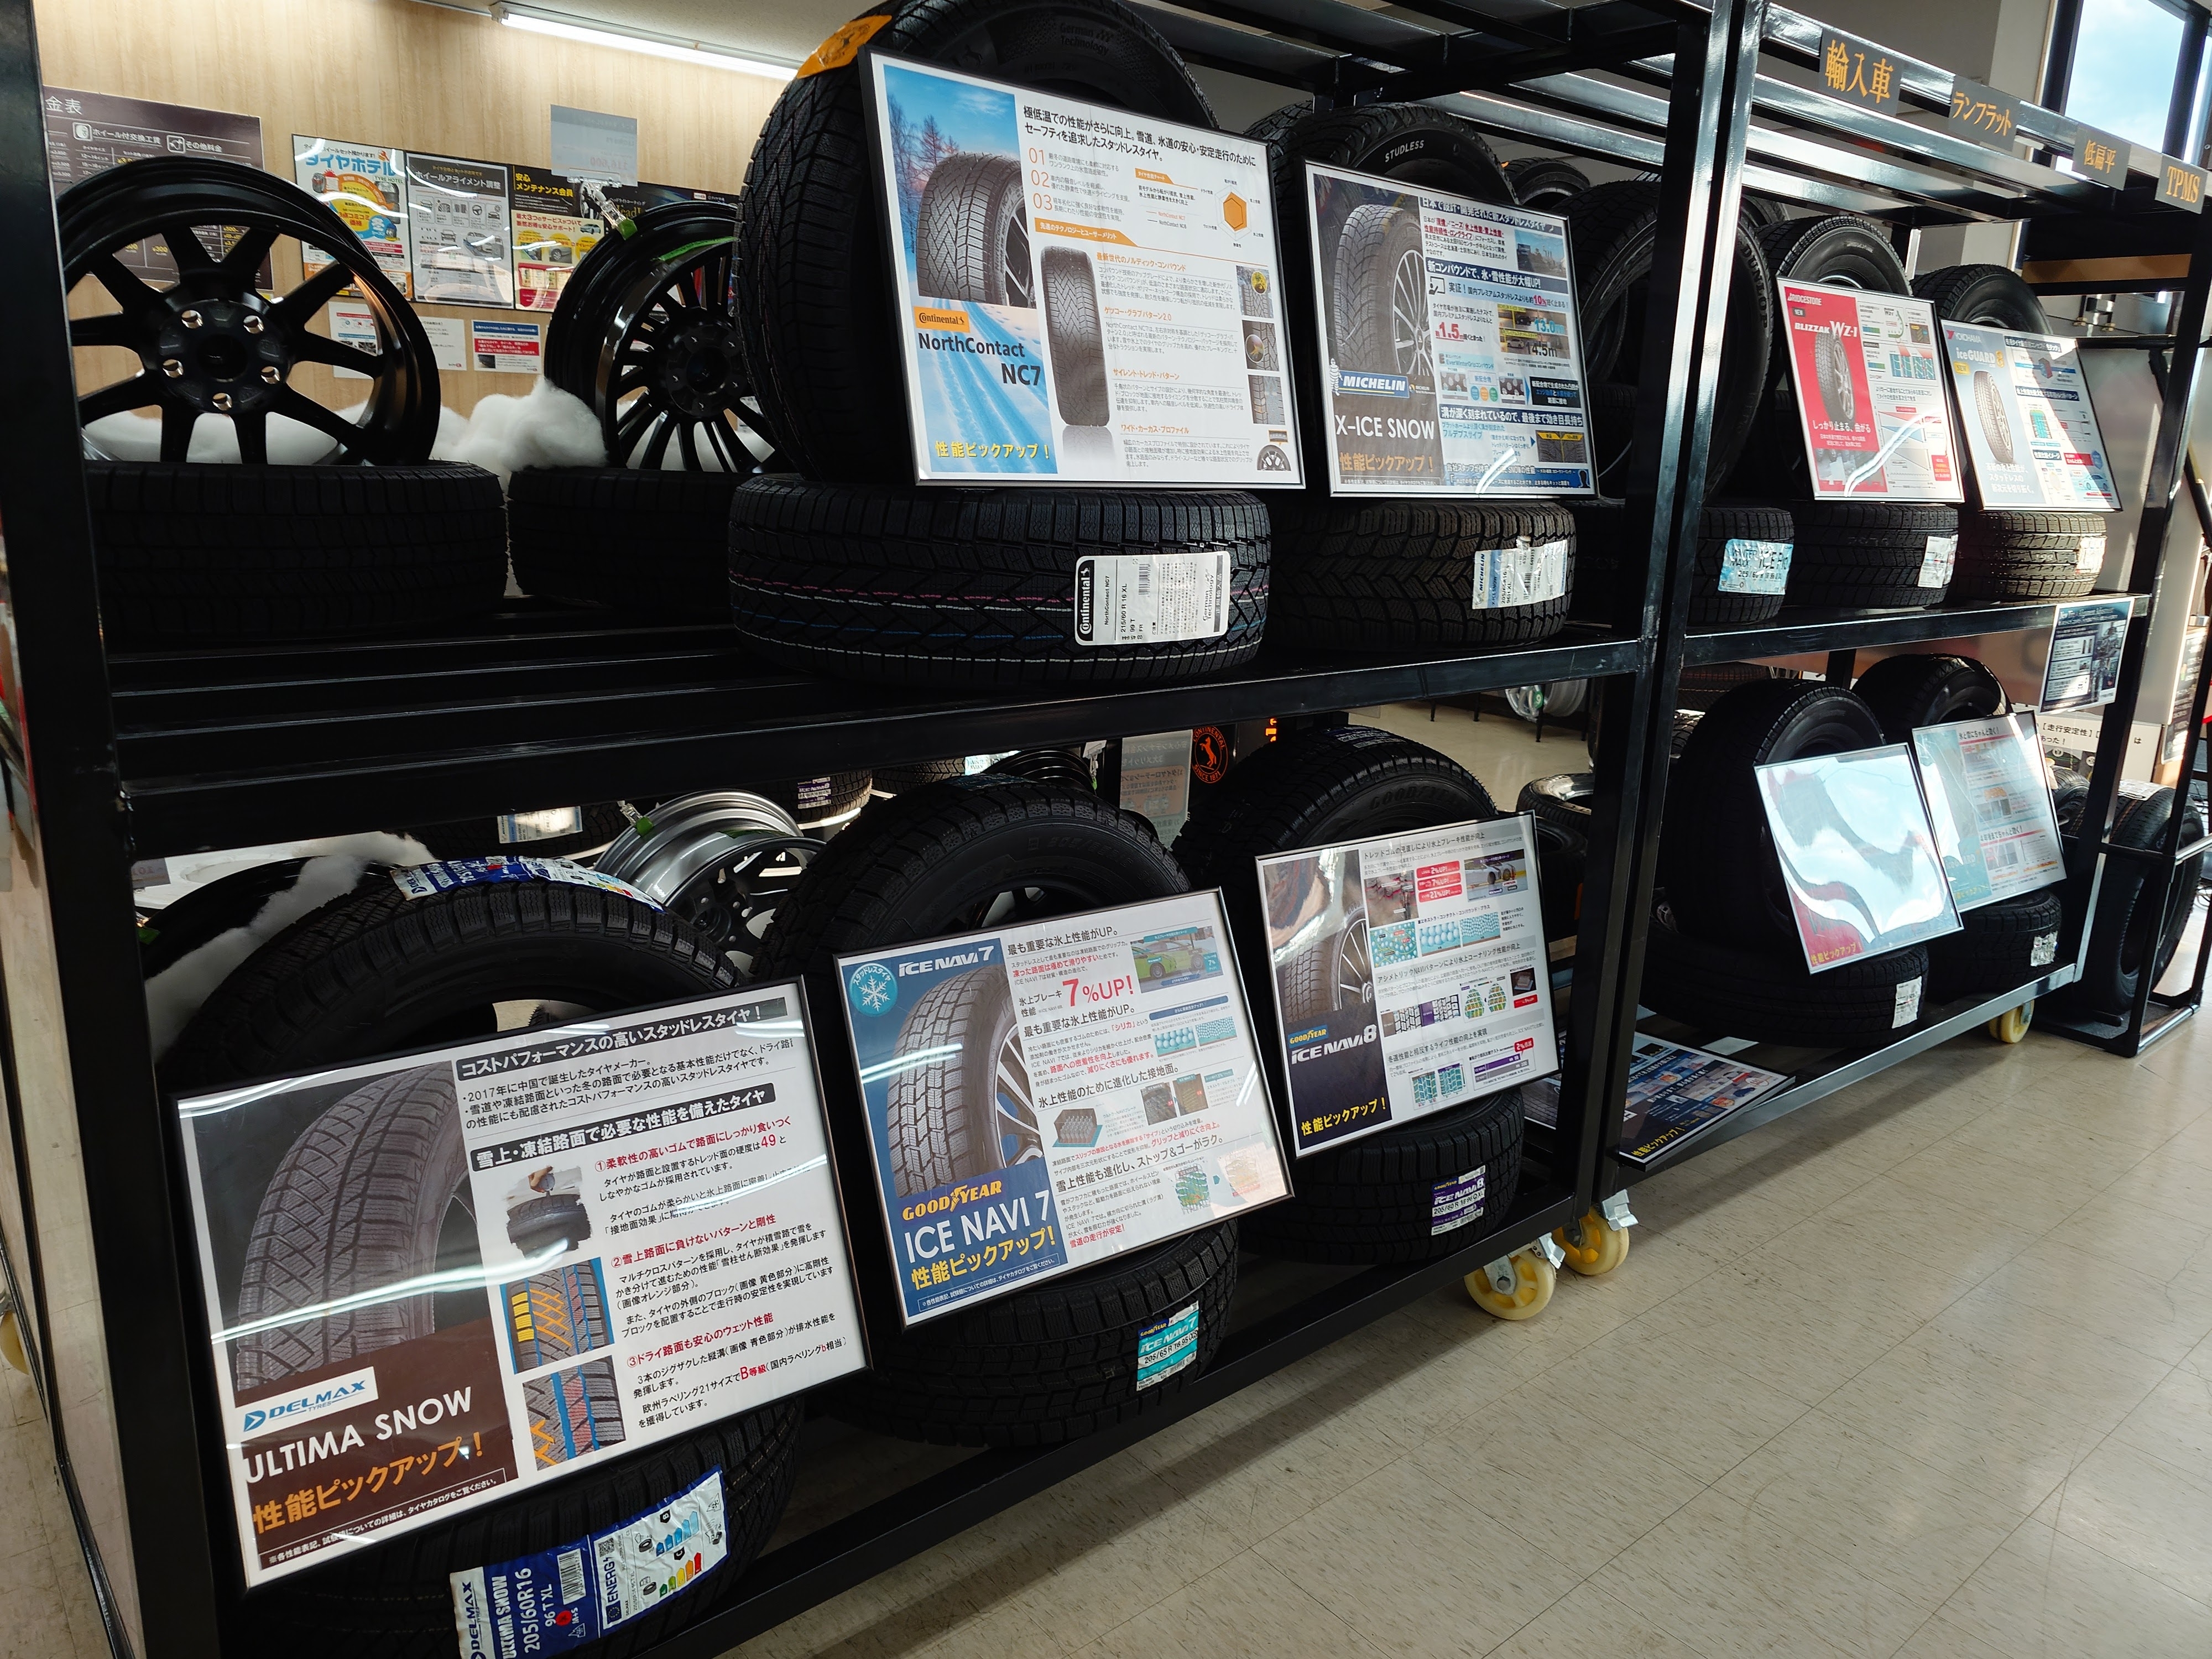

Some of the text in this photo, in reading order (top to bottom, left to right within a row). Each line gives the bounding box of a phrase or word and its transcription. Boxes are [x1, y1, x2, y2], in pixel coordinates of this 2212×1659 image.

[1825, 39, 1893, 105] 輸入車
[45, 95, 82, 115] 金表
[1953, 91, 2012, 137] ランフラット
[1029, 148, 1045, 165] 01
[1385, 140, 1424, 163] STUDLESS
[2084, 139, 2116, 174] 低扁平
[1031, 170, 1050, 187] 02
[2167, 165, 2200, 204] TPMS
[1033, 193, 1052, 210] 03
[919, 312, 958, 324] Continental
[1794, 322, 1830, 334] BLIZZAK
[919, 333, 1025, 357] NorthContact
[1955, 347, 1996, 364] iceGUARD
[1001, 363, 1040, 385] NC7
[1343, 375, 1406, 391] MICHELIN
[1335, 415, 1434, 440] X-ICE SNOW
[935, 441, 1049, 459] 性能ピックアップ！
[1340, 452, 1433, 473] 性能ピックアップ！
[1121, 583, 1127, 593] XL
[1079, 577, 1092, 634] Continental
[1192, 726, 1225, 750] CONTINENTAL
[1008, 926, 1118, 955] 最も重要な氷上性能がUP。
[853, 966, 891, 985] スタッドレスタイヤ
[898, 961, 933, 978] ICE
[1019, 989, 1062, 1006] 氷上ブレーキ
[1021, 1007, 1036, 1018] 性能
[1024, 1004, 1135, 1037] 最も重要な氷上性能がUP。
[1290, 1027, 1327, 1045] GOODYEAR
[1291, 1024, 1377, 1066] ICE NAVI 8
[1301, 1097, 1386, 1137] 性能ピックアップ！
[902, 1180, 1002, 1221] GOODYEAR
[1434, 1178, 1484, 1205] ICE NAVI 8
[905, 1190, 1050, 1263] ICE NAVI 7
[1070, 1223, 1125, 1248] 雪道の走行が安定!
[911, 1225, 1056, 1291] 性能ピックアップ!
[1140, 1316, 1197, 1354] ICE NAVI 7
[1145, 1348, 1167, 1364] 205/65
[269, 1380, 366, 1418] DELMAX
[633, 1379, 680, 1399] 発揮します。
[307, 1401, 332, 1412] TYRES
[638, 1401, 709, 1428] を獲得しています。
[244, 1386, 471, 1484] ULTIMA SNOW
[253, 1432, 483, 1535] 性能ピックアップ！
[540, 1584, 553, 1601] XL
[462, 1581, 479, 1650] DELMAX
[492, 1575, 517, 1659] ULTIMA SNOW
[515, 1568, 540, 1653] 205/60R16
[544, 1611, 556, 1627] 96
[571, 1607, 580, 1624] M+S
